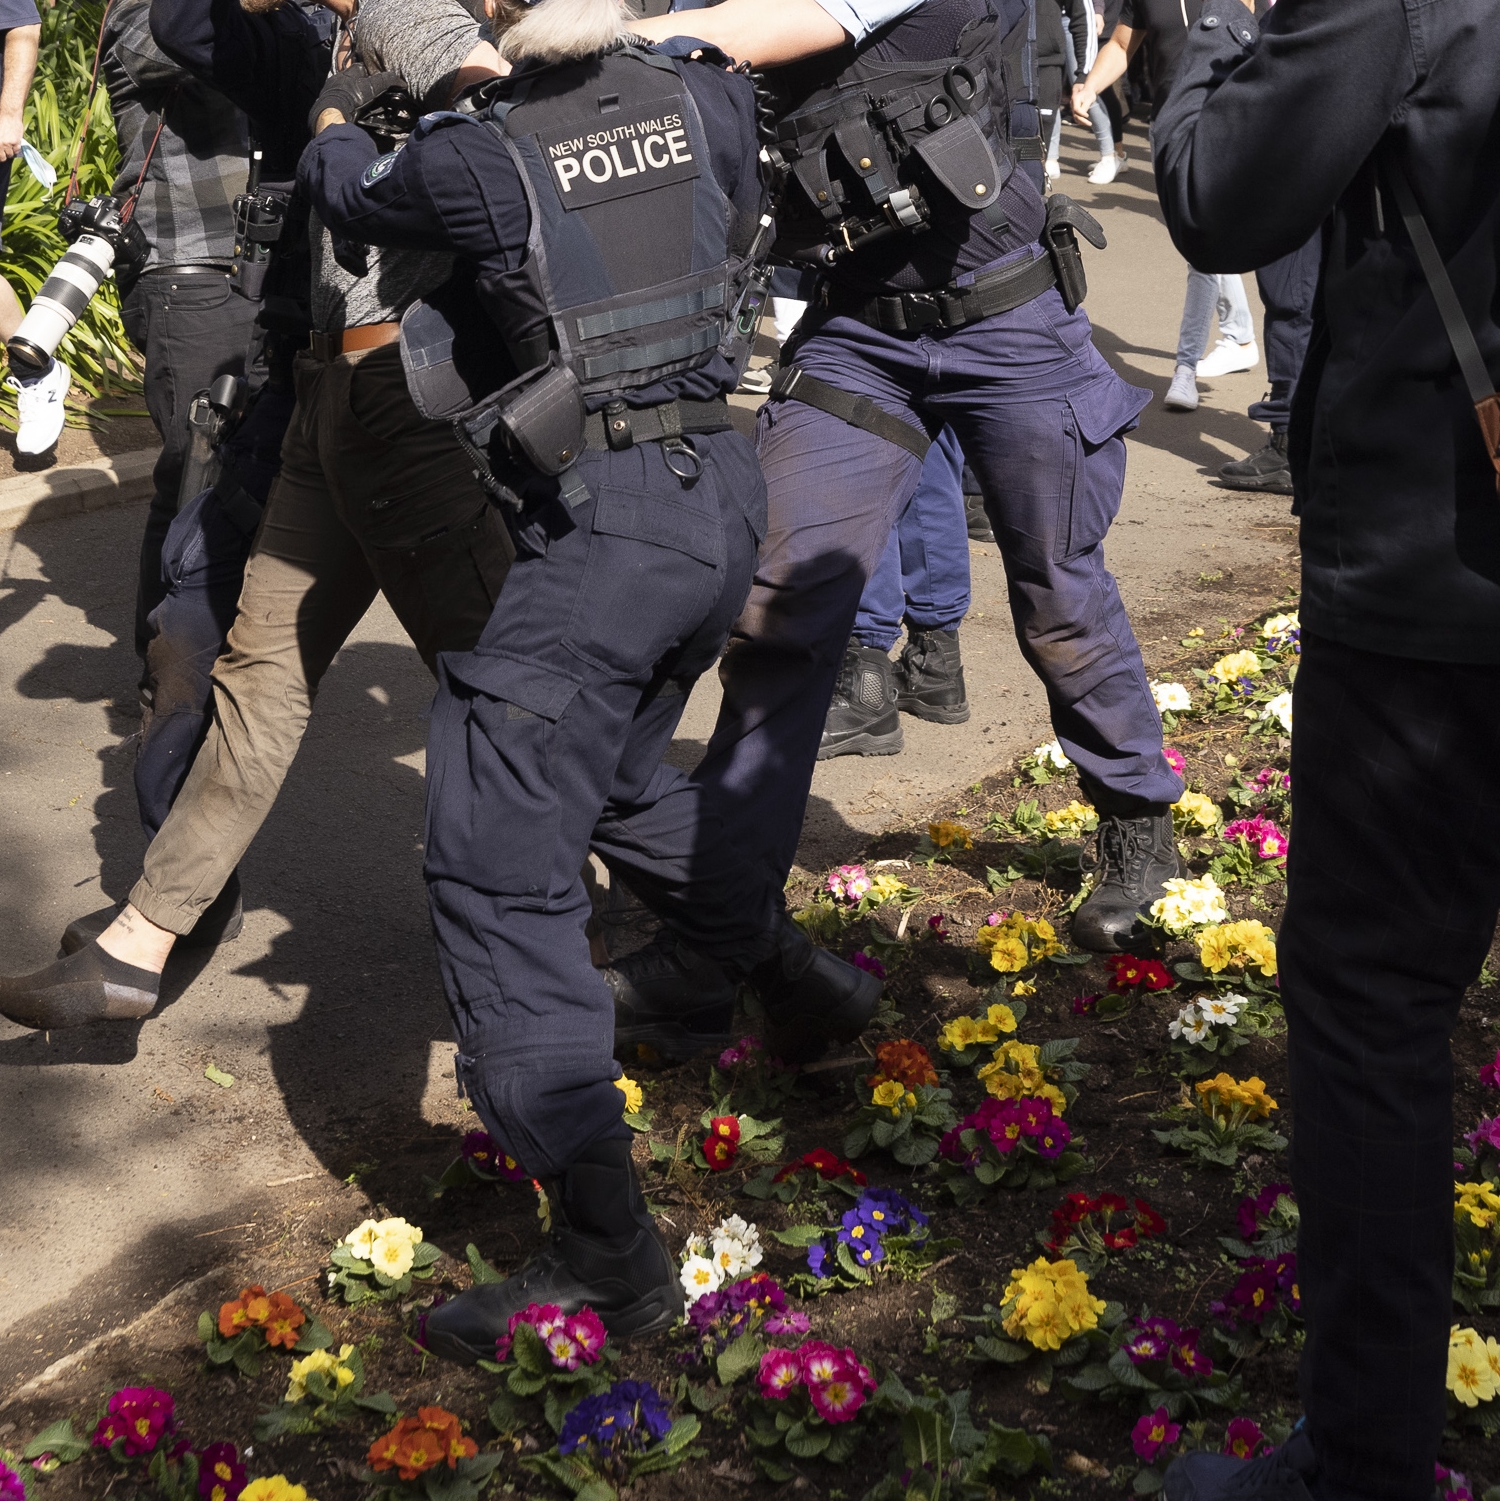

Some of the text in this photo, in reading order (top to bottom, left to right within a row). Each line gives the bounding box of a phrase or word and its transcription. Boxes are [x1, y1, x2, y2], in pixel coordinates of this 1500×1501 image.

[549, 114, 682, 158] NEW SOUTH WALES
[553, 129, 693, 193] POLICE
